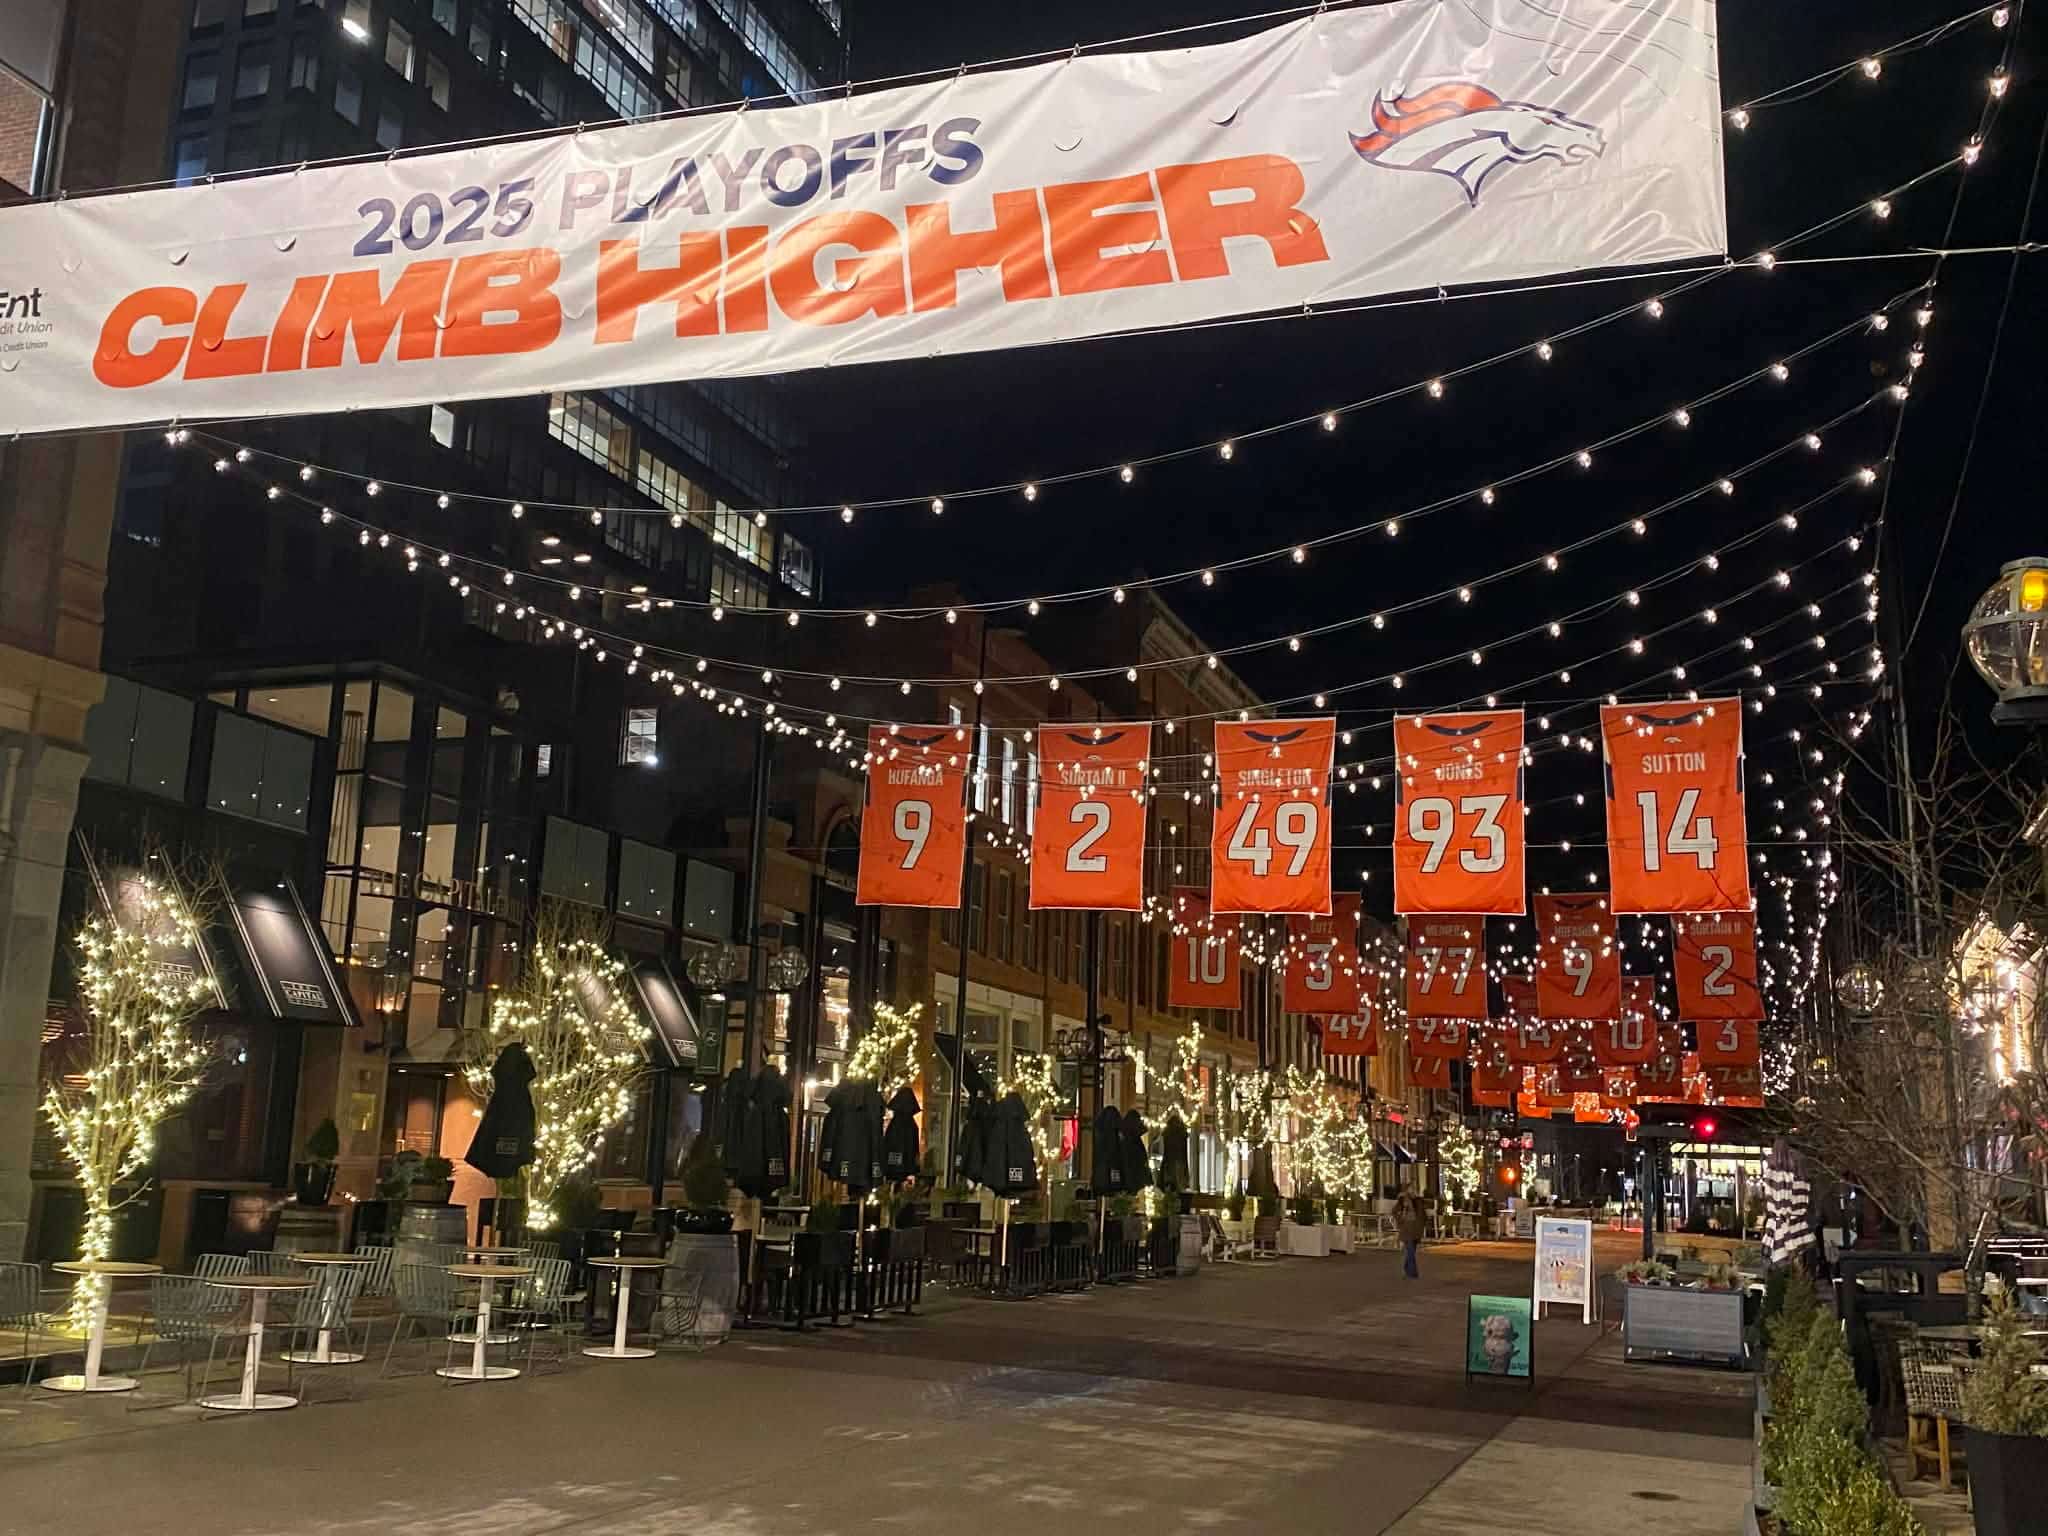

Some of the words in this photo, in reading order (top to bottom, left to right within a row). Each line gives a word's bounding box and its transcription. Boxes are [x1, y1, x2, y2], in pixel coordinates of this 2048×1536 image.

[353, 178, 537, 256] 2025
[559, 117, 984, 230] PLAYOFFS
[92, 247, 562, 389] CLIMB
[594, 153, 1330, 345] HIGHER
[17, 321, 53, 333] Union
[1238, 768, 1312, 787] SINGLETON
[1642, 752, 1706, 774] SUTTON
[893, 800, 932, 870] 9
[1065, 801, 1112, 872] 2
[1227, 801, 1318, 876] 49
[1408, 793, 1508, 873] 93
[1636, 788, 1718, 872] 14
[1188, 936, 1226, 984] 10
[1305, 943, 1333, 990] 3
[1415, 947, 1476, 995] 77
[1563, 948, 1592, 996] 9
[1701, 945, 1735, 996] 2
[1610, 1012, 1643, 1050] 10
[1715, 1019, 1739, 1052] 3
